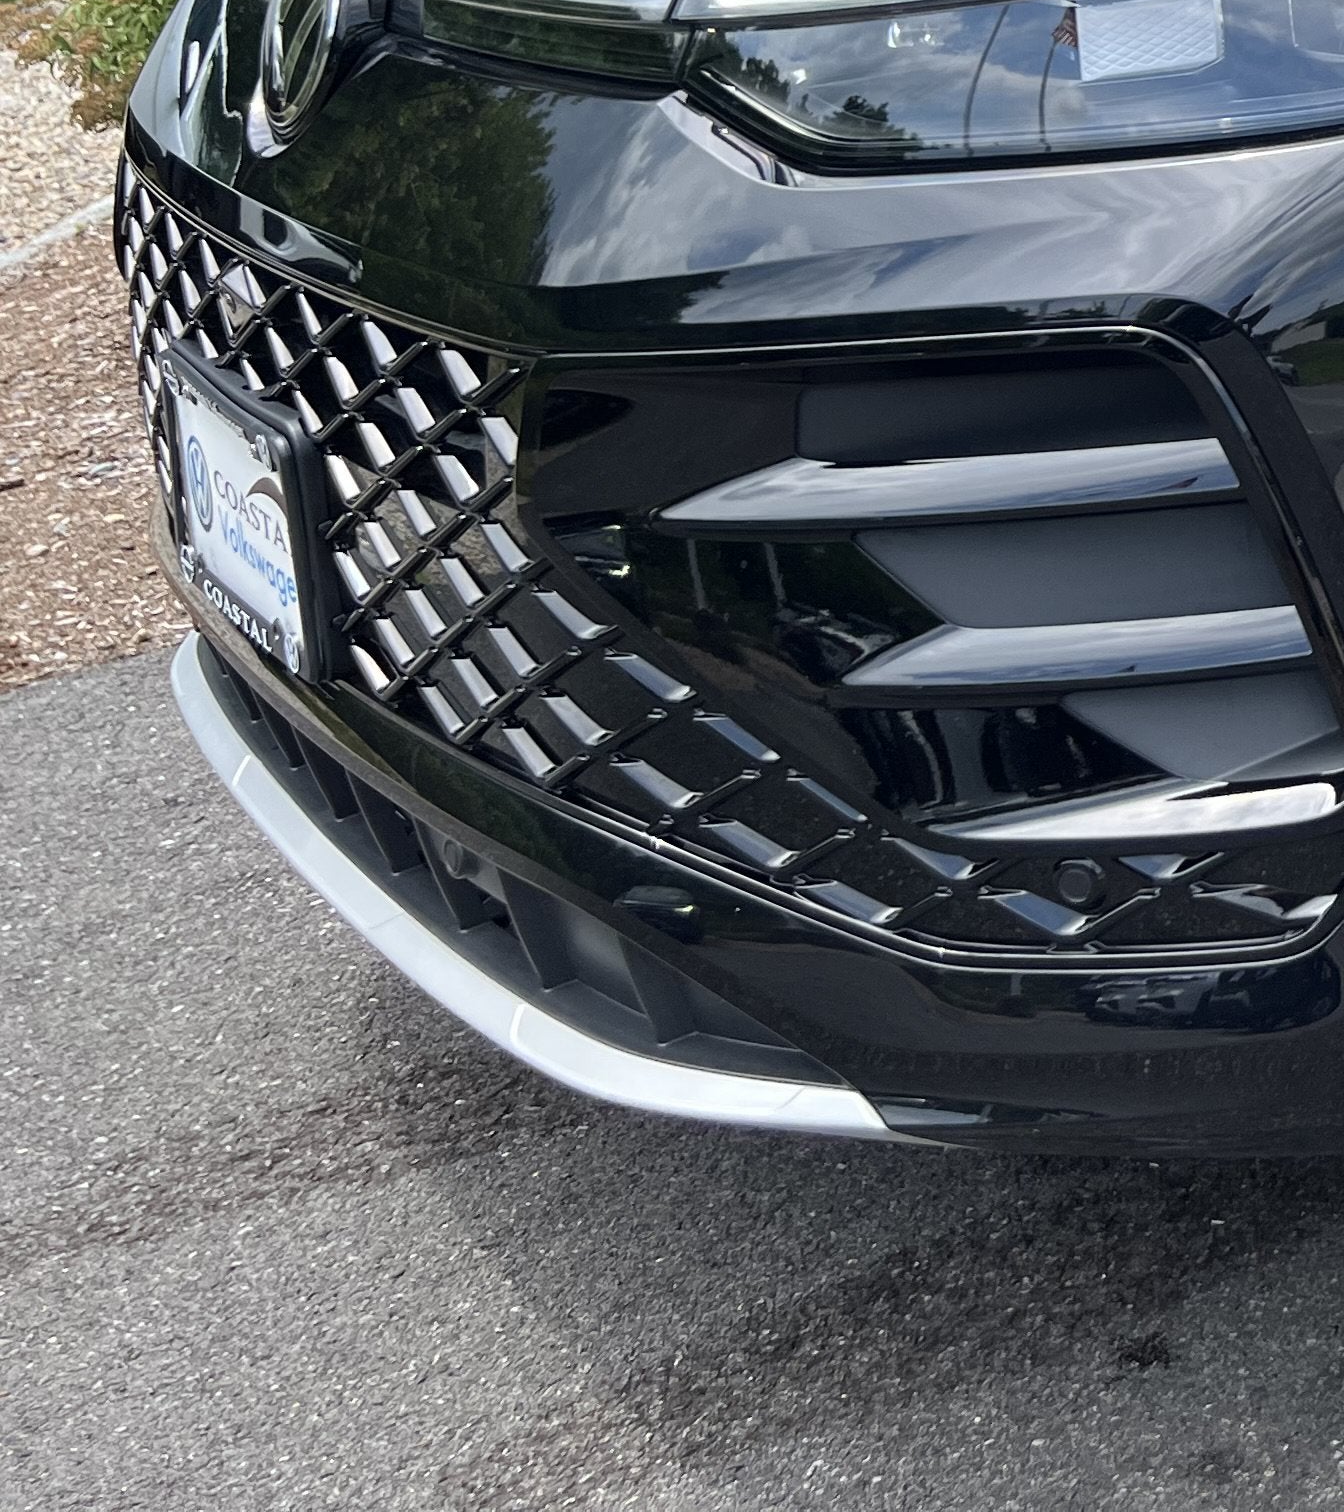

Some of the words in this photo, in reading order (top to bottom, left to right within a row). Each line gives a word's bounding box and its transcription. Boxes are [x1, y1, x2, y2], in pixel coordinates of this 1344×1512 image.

[213, 469, 290, 555] COASTA
[217, 504, 298, 608] Volkswage
[203, 578, 273, 653] COASTAL
